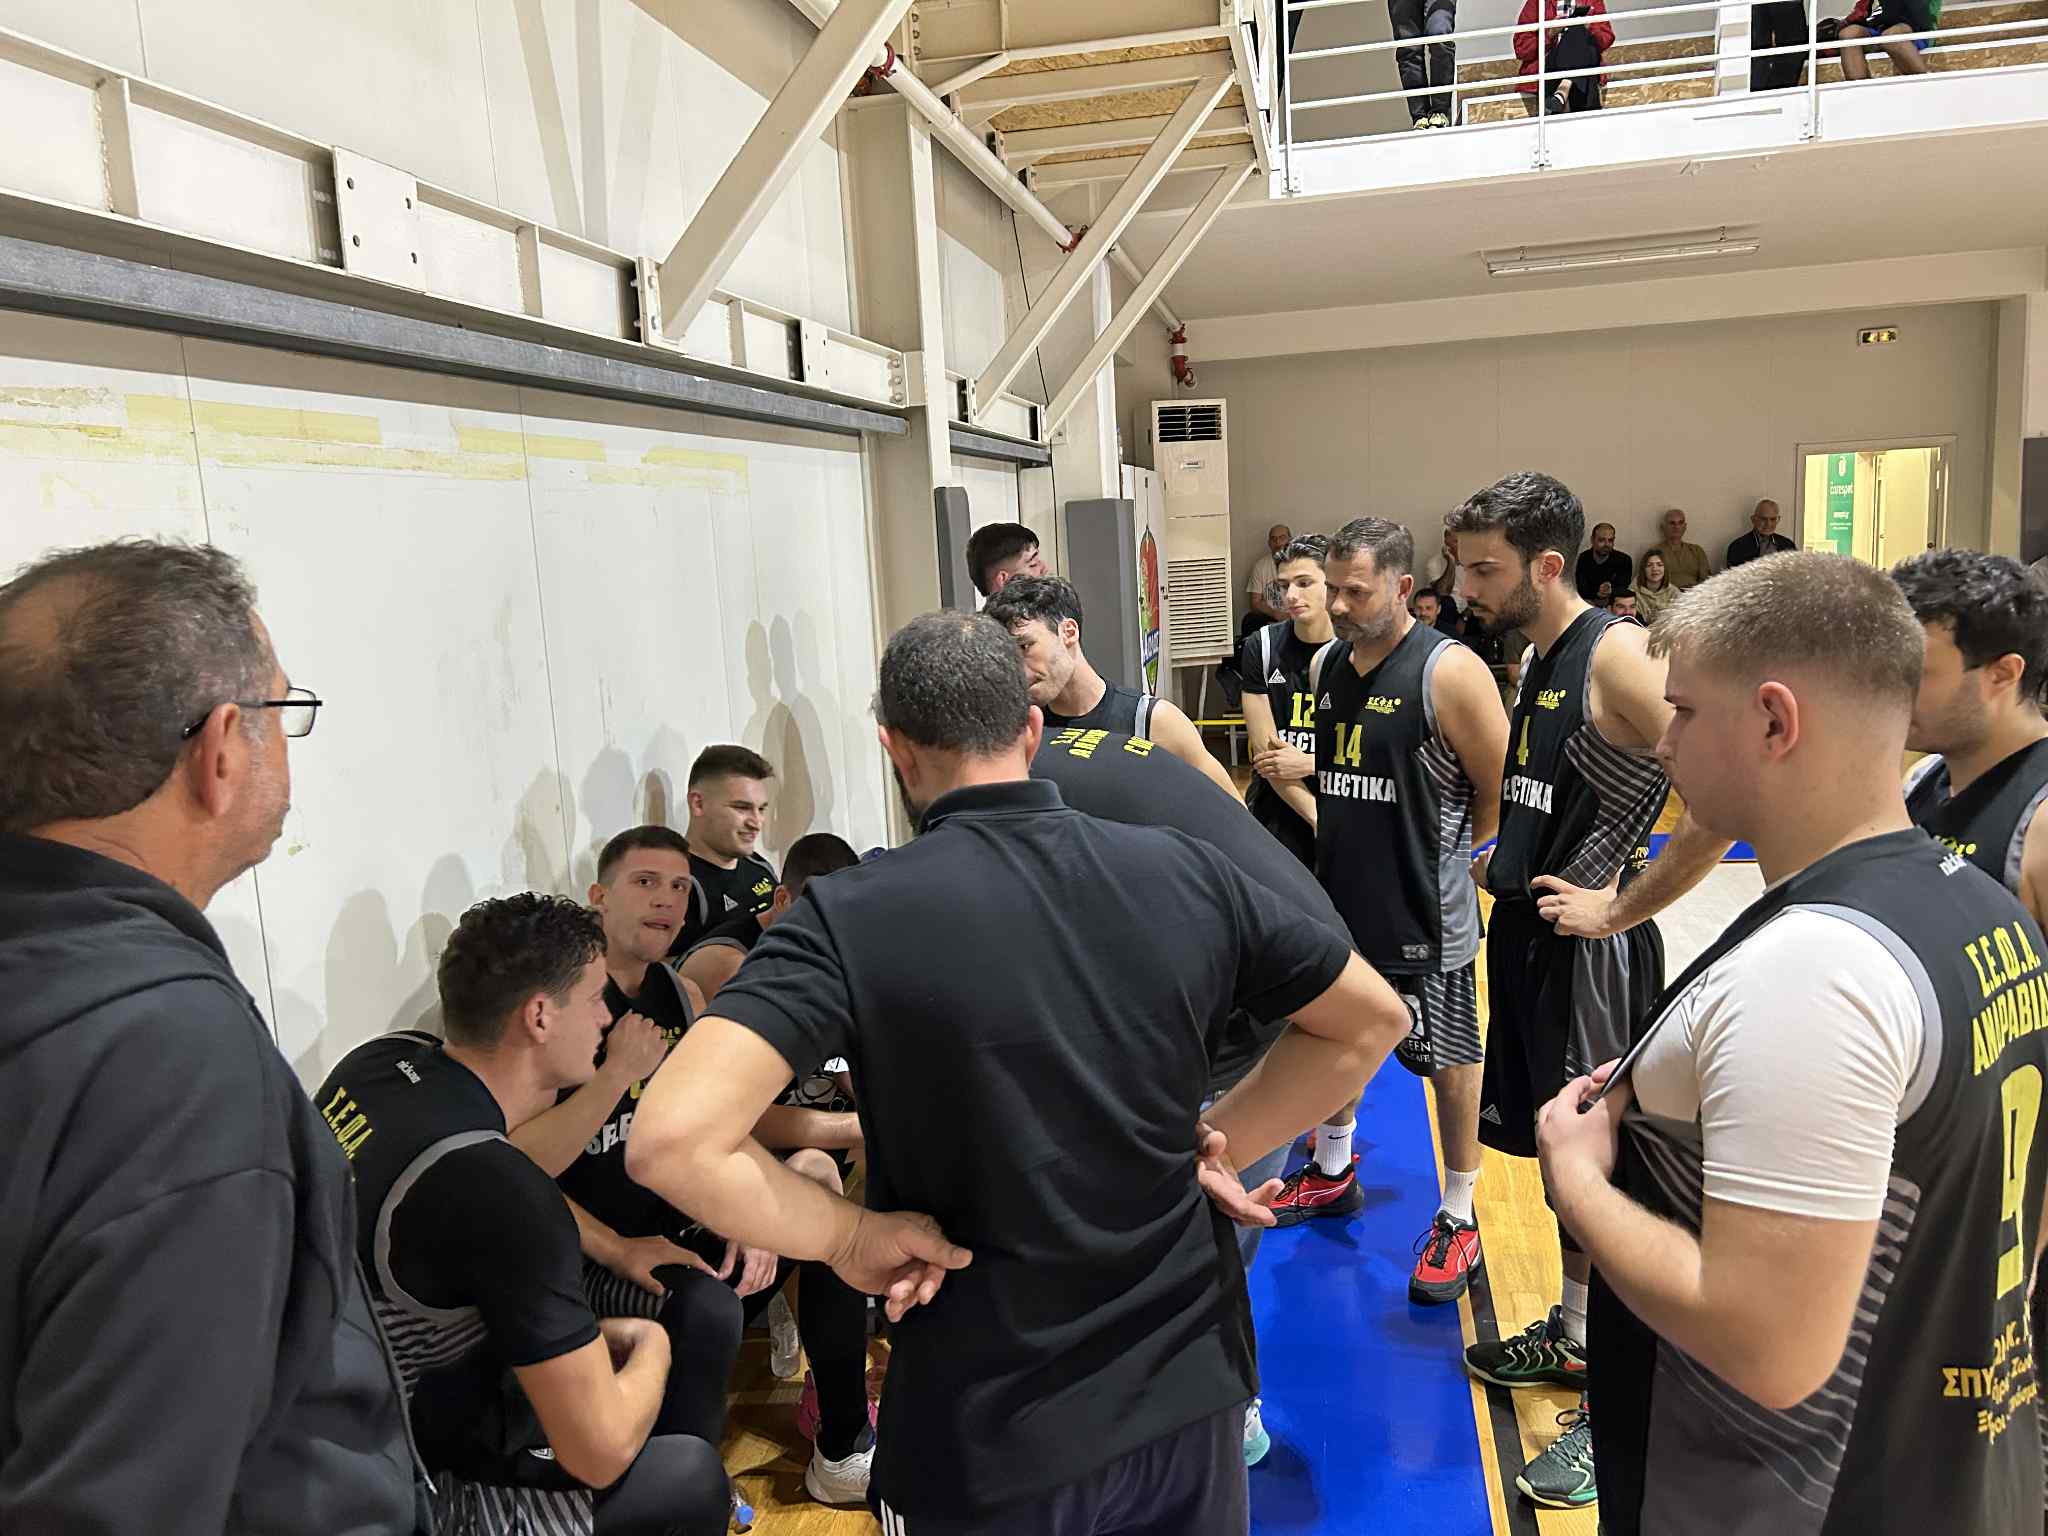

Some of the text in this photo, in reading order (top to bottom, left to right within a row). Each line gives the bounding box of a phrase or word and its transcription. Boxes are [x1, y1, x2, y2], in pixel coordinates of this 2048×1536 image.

[1290, 692, 1316, 728] 12
[1333, 722, 1363, 768] 14
[1997, 1063, 2043, 1300] 9
